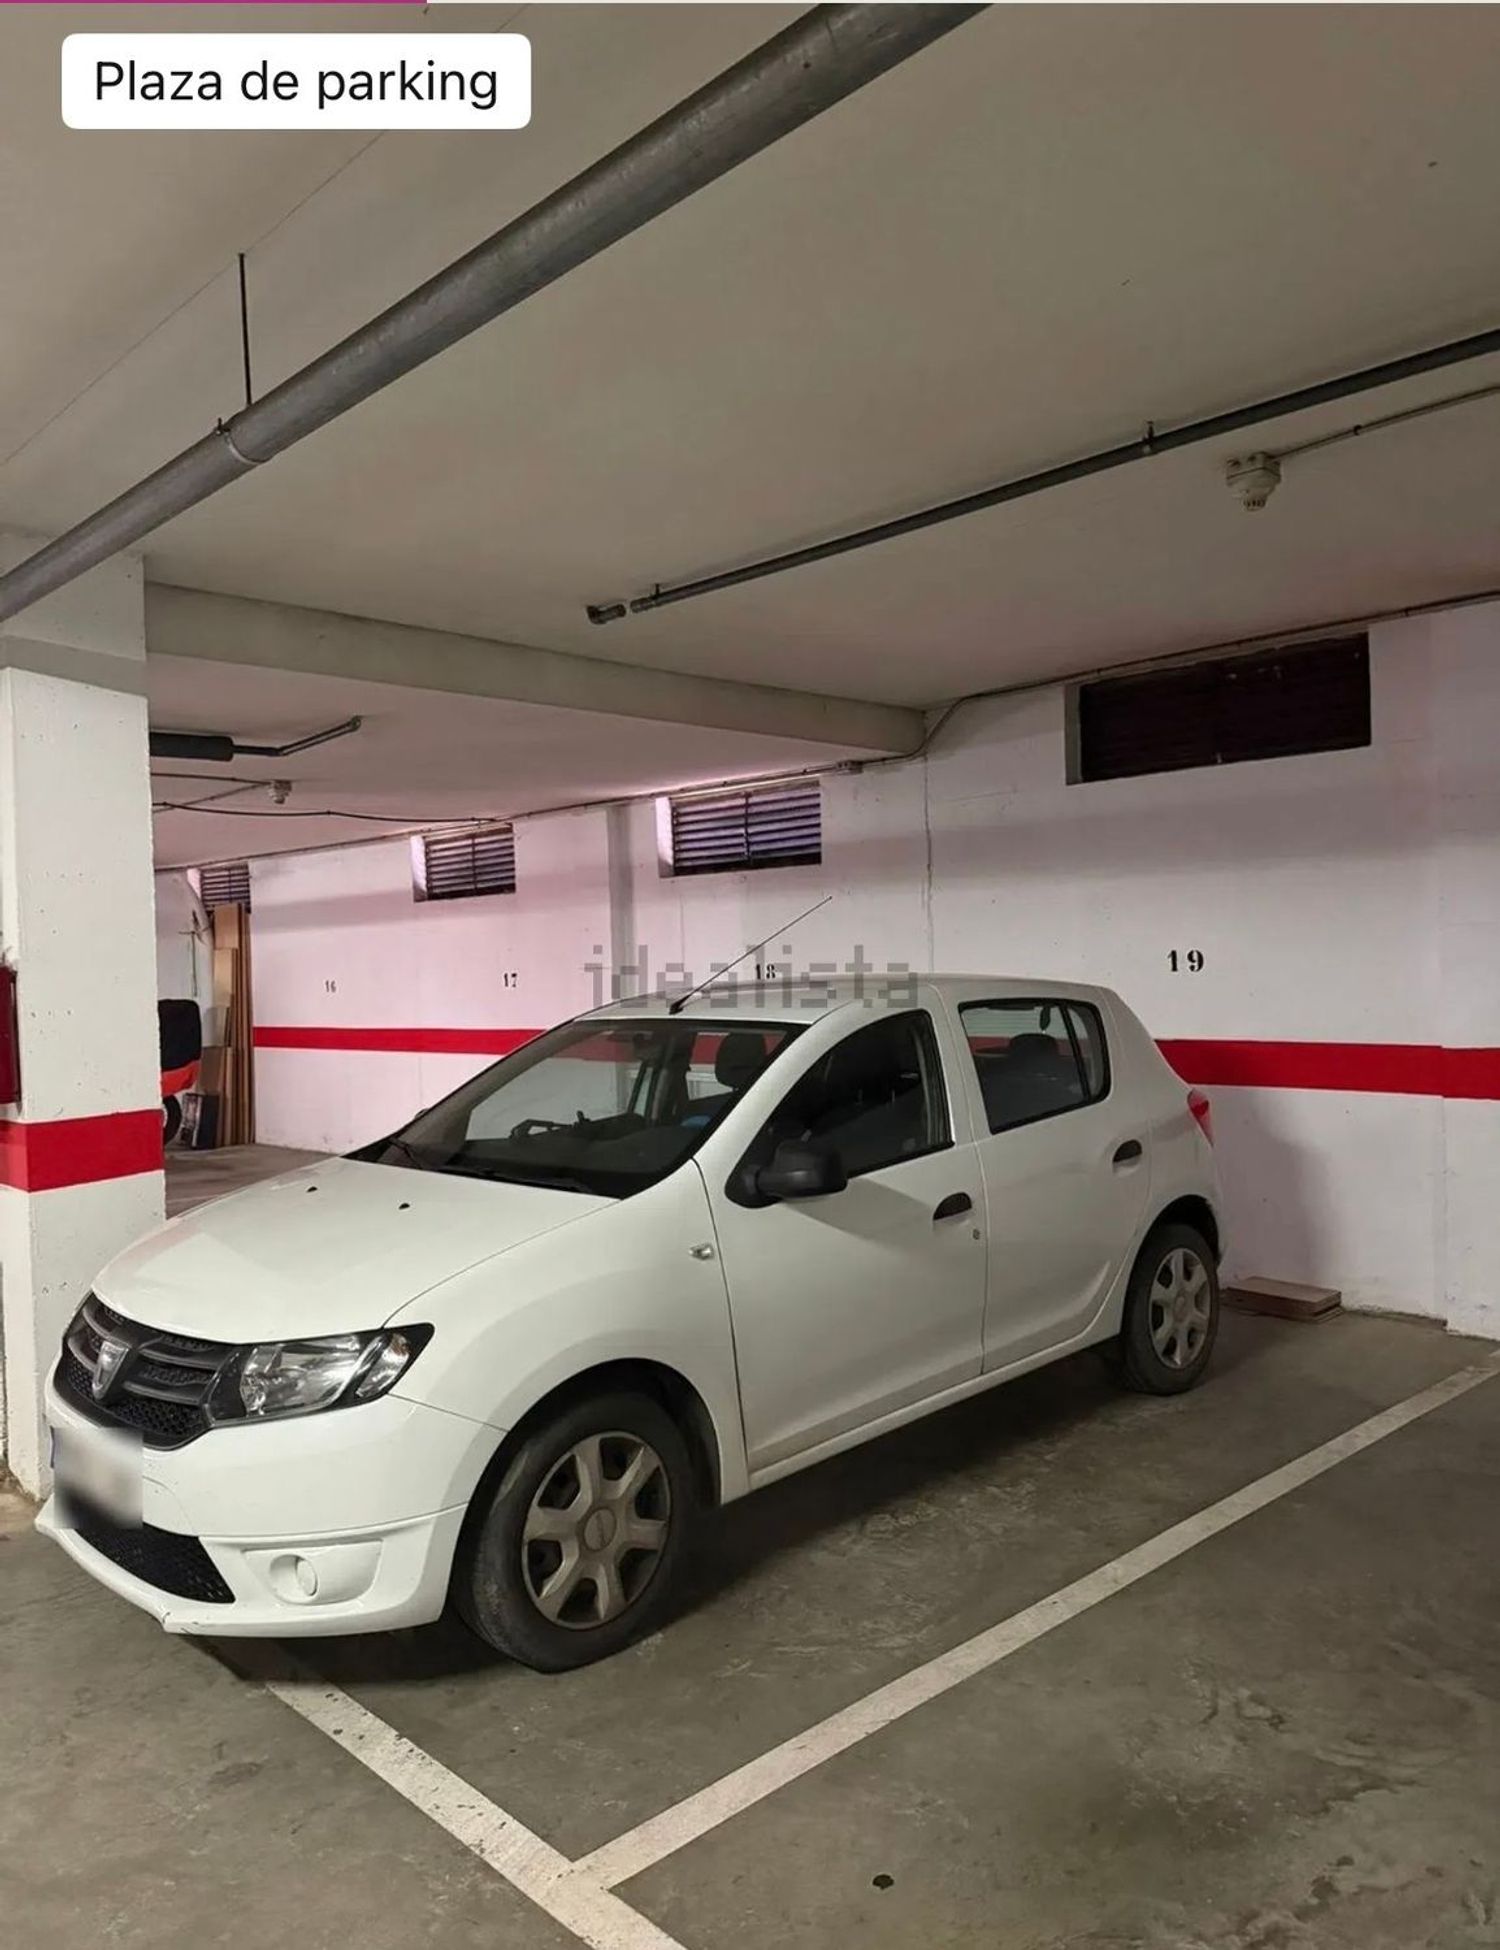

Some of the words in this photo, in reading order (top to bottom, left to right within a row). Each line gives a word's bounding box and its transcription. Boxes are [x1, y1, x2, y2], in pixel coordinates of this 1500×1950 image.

[1167, 949, 1204, 972] 19
[756, 963, 776, 980] 18
[324, 979, 337, 993] 16
[503, 972, 518, 988] 17
